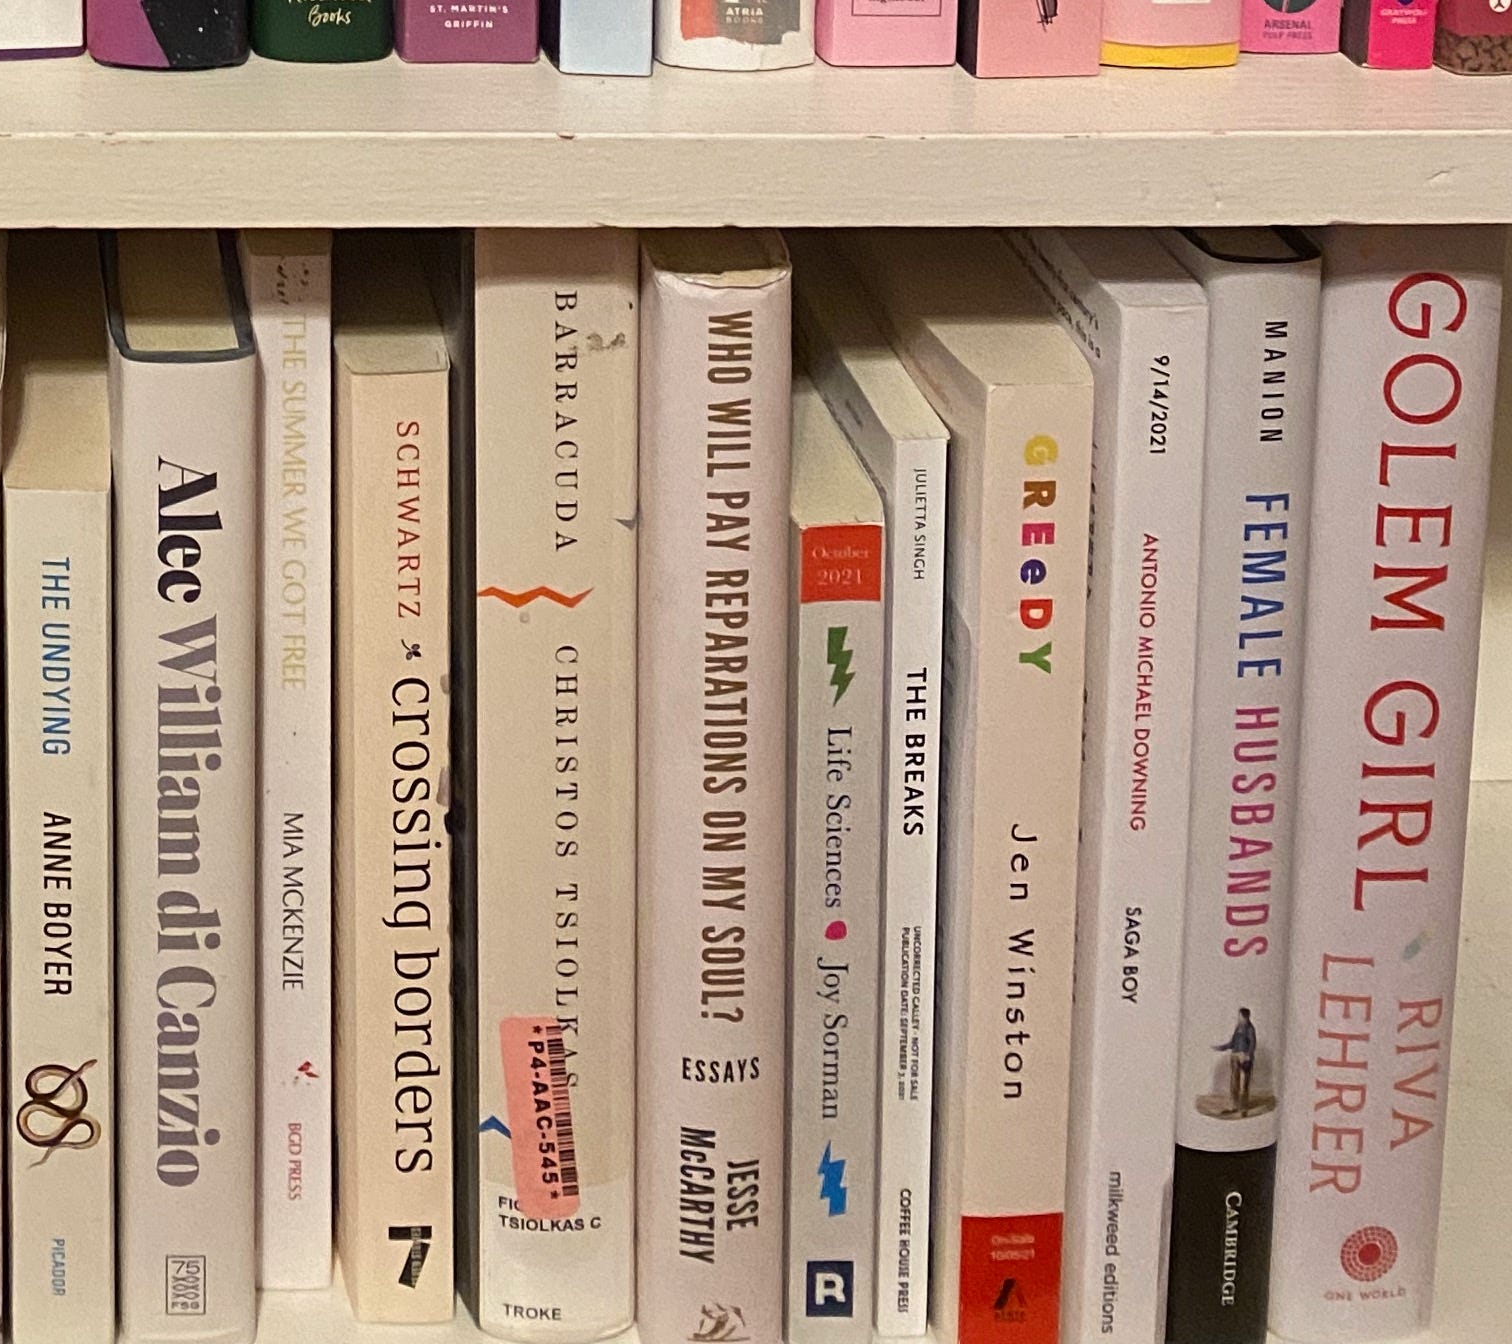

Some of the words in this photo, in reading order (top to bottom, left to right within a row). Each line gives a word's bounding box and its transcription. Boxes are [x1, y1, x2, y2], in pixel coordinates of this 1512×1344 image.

[308, 5, 351, 25] Books
[445, 20, 493, 28] GRIFFIN
[1149, 354, 1170, 455] 9/14/2021
[1260, 320, 1288, 443] MANION
[554, 291, 579, 551] BARRACUDA
[396, 420, 422, 618] SCHWARTZ
[914, 469, 927, 531] JULIETTA
[41, 557, 70, 609] THE
[812, 548, 870, 561] October
[817, 570, 862, 585] 2021
[914, 535, 925, 580] SINGH
[41, 623, 71, 756] UNDYING
[43, 812, 72, 891] ANNE
[283, 812, 304, 858] MIA
[1009, 823, 1038, 901] Jen
[44, 902, 73, 996] BOYER
[283, 866, 305, 990] MCKENZIE
[1125, 907, 1143, 959] SAGA
[817, 956, 849, 1005] Joy
[1003, 928, 1035, 1100] Winston
[1122, 966, 1138, 1004] BOY
[683, 1056, 760, 1083] ESSAYS
[822, 1013, 848, 1121] Sorman
[1308, 952, 1376, 1195] LEHRER
[1389, 997, 1443, 1151] RIVA
[726, 1159, 759, 1231] JESSE
[503, 1304, 561, 1321] TROKE
